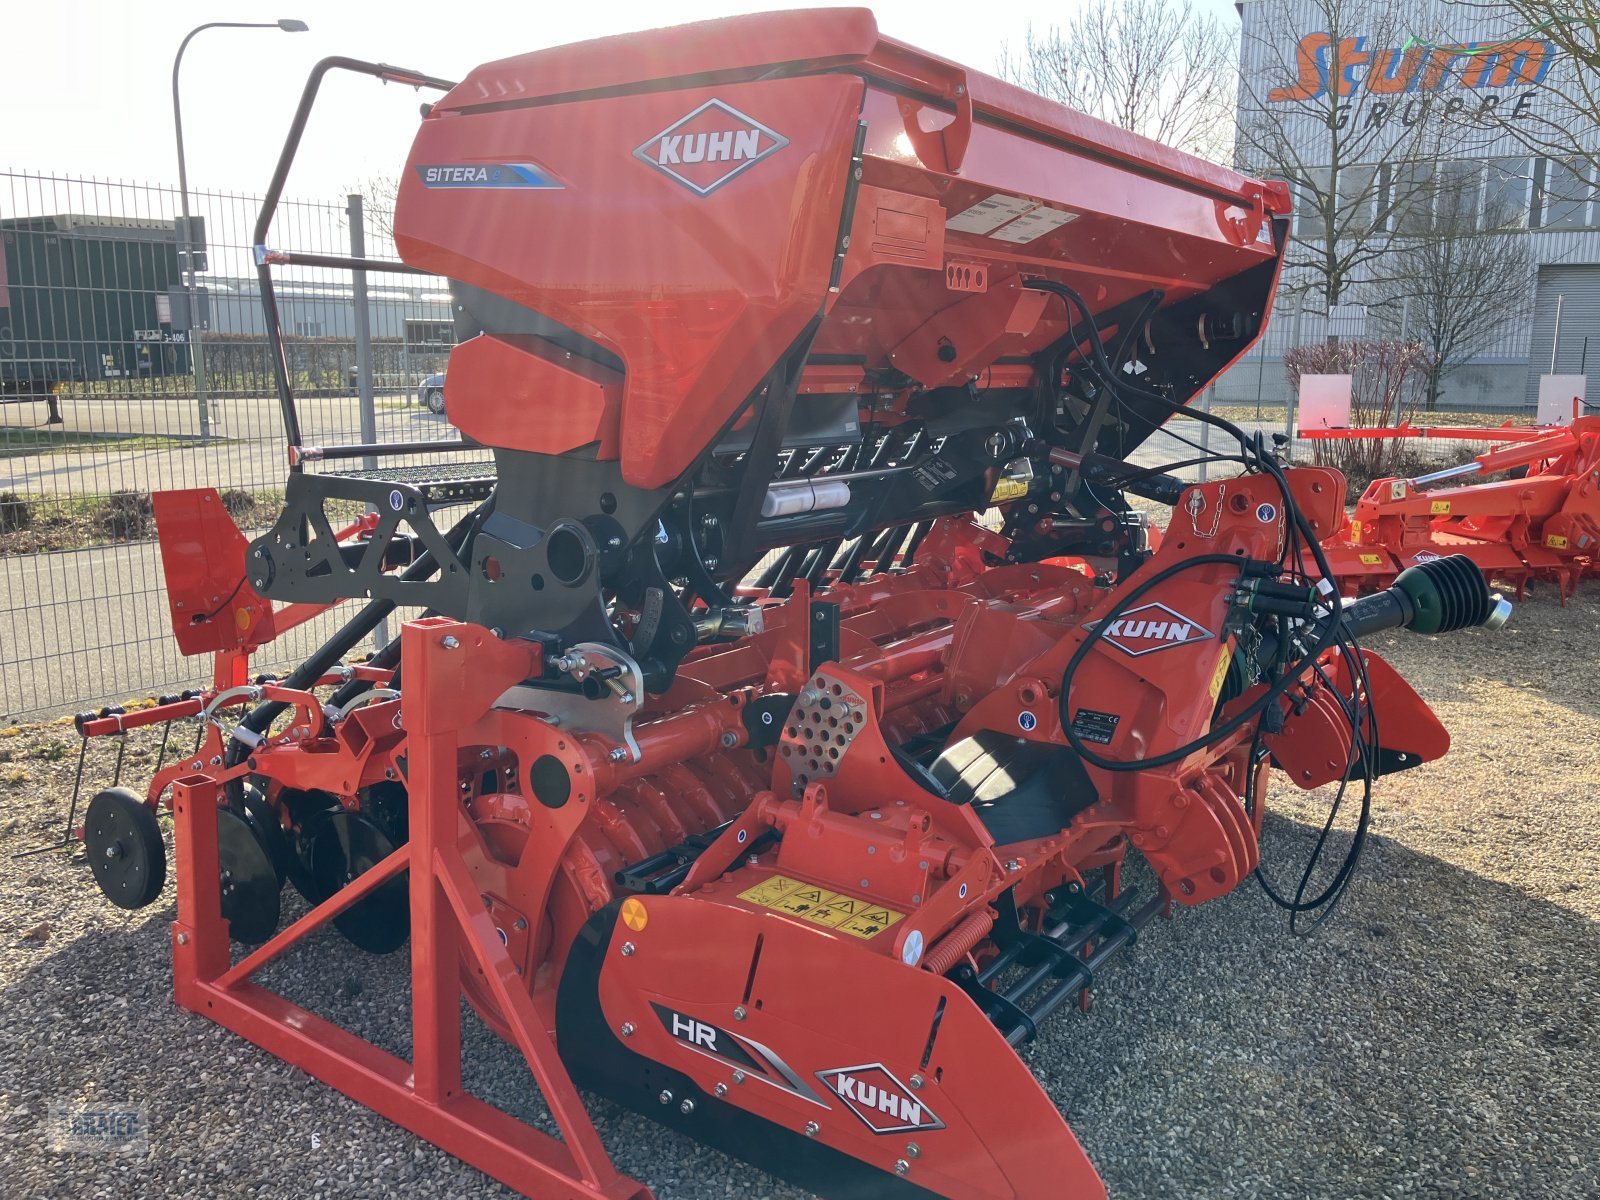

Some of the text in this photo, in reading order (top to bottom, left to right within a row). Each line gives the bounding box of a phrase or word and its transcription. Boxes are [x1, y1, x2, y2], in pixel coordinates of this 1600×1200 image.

[1266, 31, 1554, 103] Sturm
[1326, 92, 1537, 130] GRUPPE
[658, 129, 760, 165] KUHN
[426, 167, 488, 182] SITERA
[1102, 620, 1192, 640] KUHN
[672, 1013, 718, 1051] HR
[837, 1072, 921, 1127] KUHN
